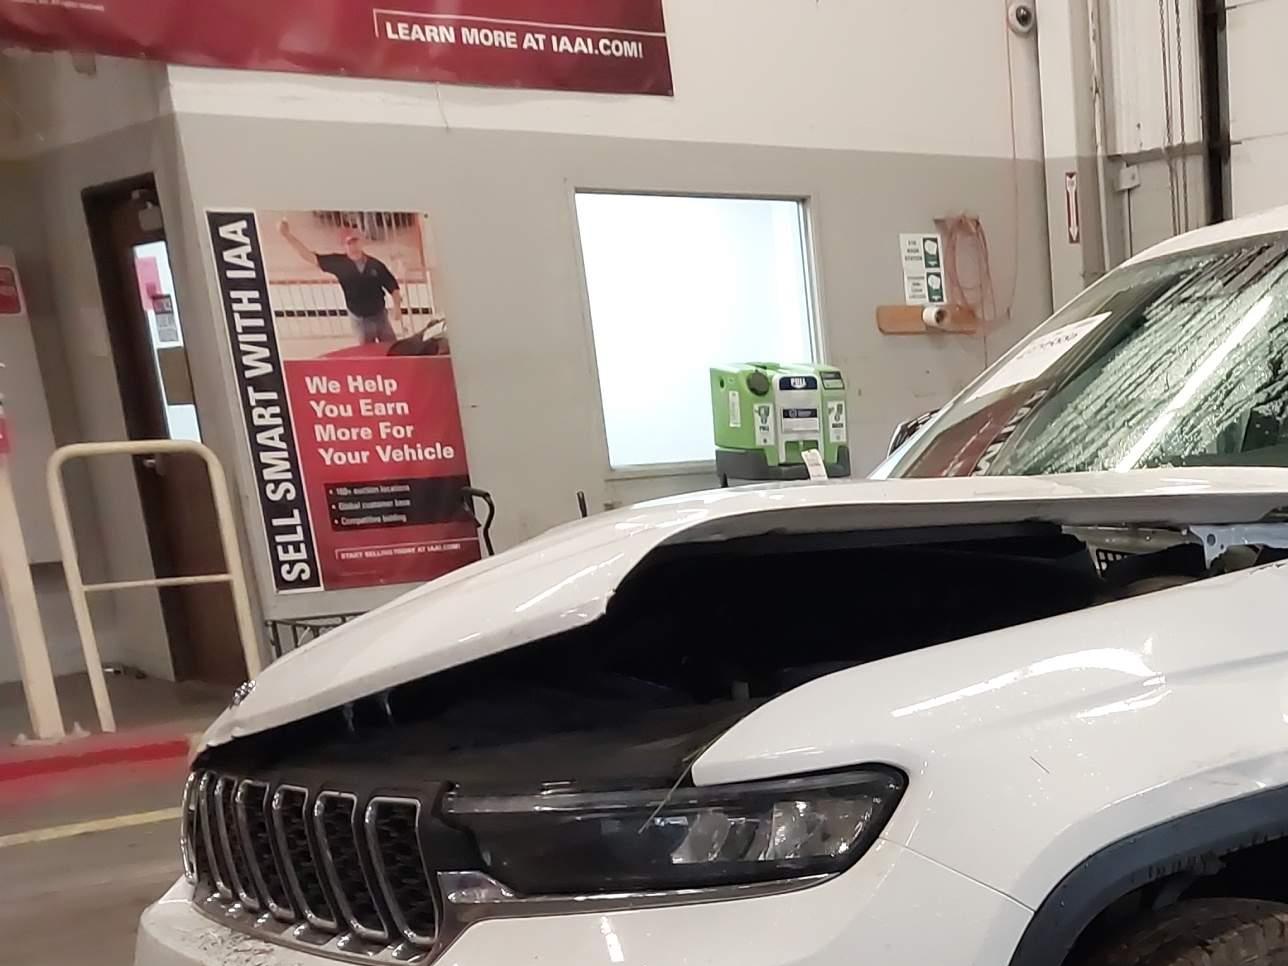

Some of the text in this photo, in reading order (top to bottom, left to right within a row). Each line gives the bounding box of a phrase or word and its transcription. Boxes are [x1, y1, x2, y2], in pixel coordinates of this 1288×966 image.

[385, 22, 644, 59] LEARN MORE AT IAAI.COM!
[305, 374, 398, 395] We Help
[218, 219, 311, 582] SELL SMART WITH IAA
[309, 398, 409, 418] You Earn
[314, 421, 414, 442] More For
[318, 442, 455, 465] Your Vehicle
